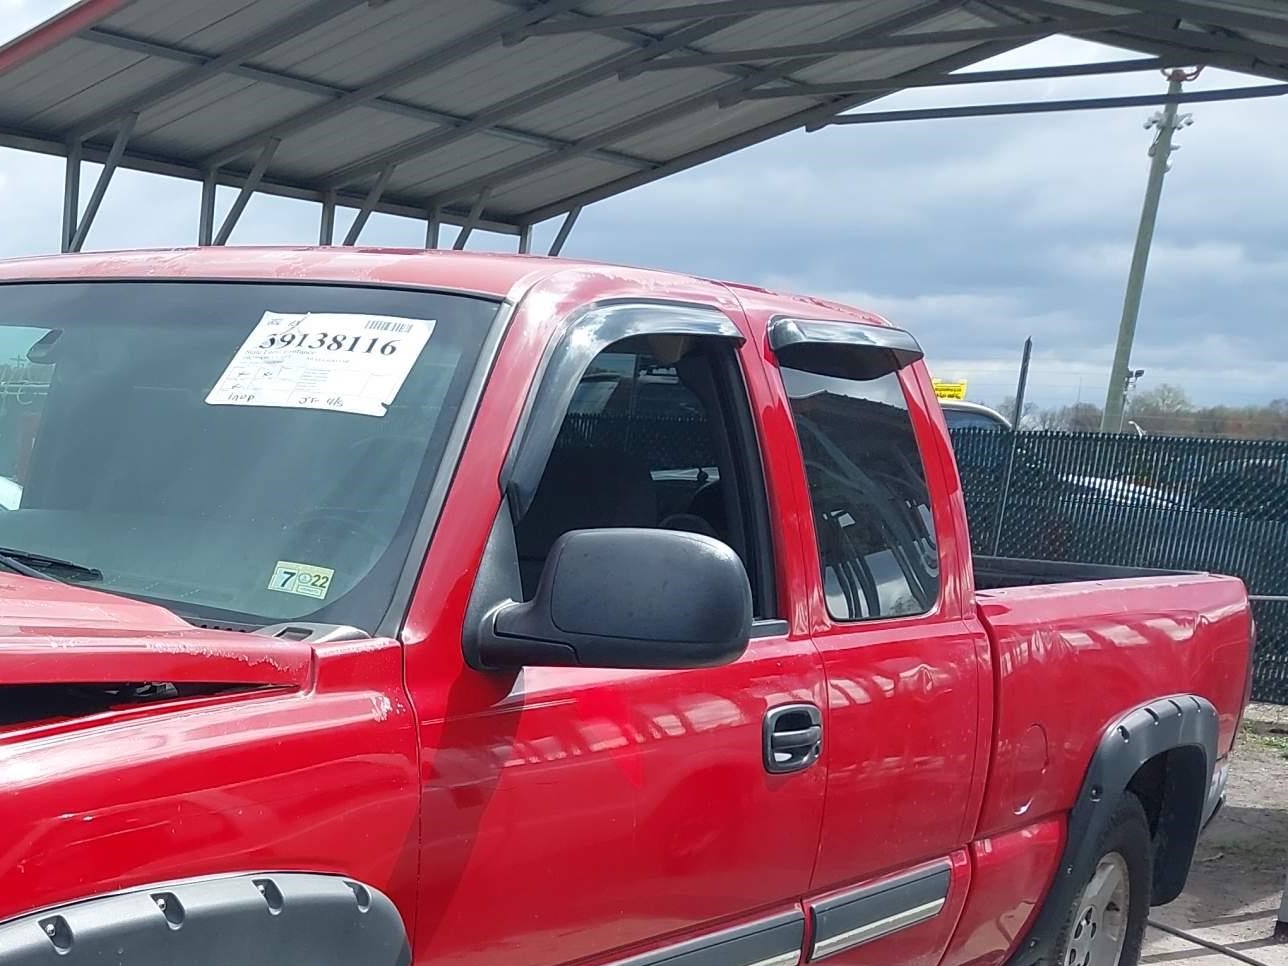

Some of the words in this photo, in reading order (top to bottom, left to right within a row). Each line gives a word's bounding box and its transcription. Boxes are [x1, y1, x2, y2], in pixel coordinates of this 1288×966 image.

[258, 332, 400, 357] 39138116
[280, 571, 296, 588] 7
[311, 574, 329, 589] 22
